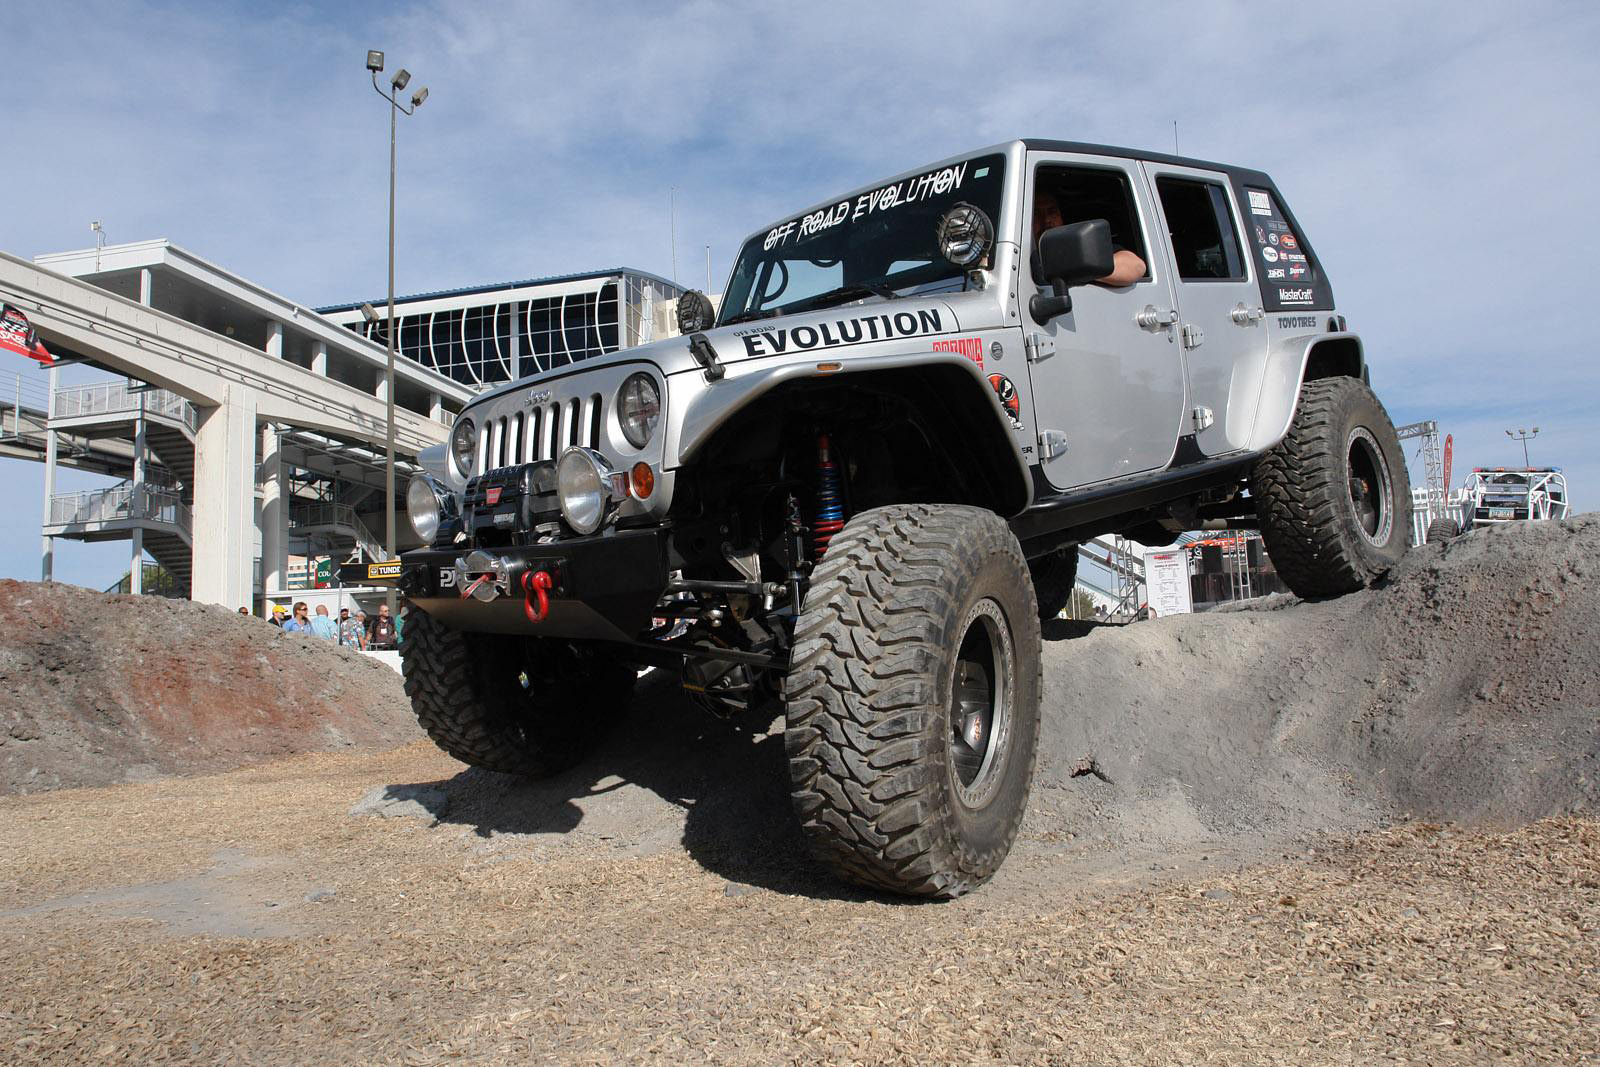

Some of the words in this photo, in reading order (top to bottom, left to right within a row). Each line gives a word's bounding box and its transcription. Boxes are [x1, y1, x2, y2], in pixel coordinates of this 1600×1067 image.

[763, 221, 797, 251] OFF
[797, 202, 849, 242] ROAD
[852, 161, 968, 223] EVOLUTION
[733, 329, 749, 337] OFF
[751, 325, 775, 334] ROAD
[741, 309, 942, 357] EVOLUTION
